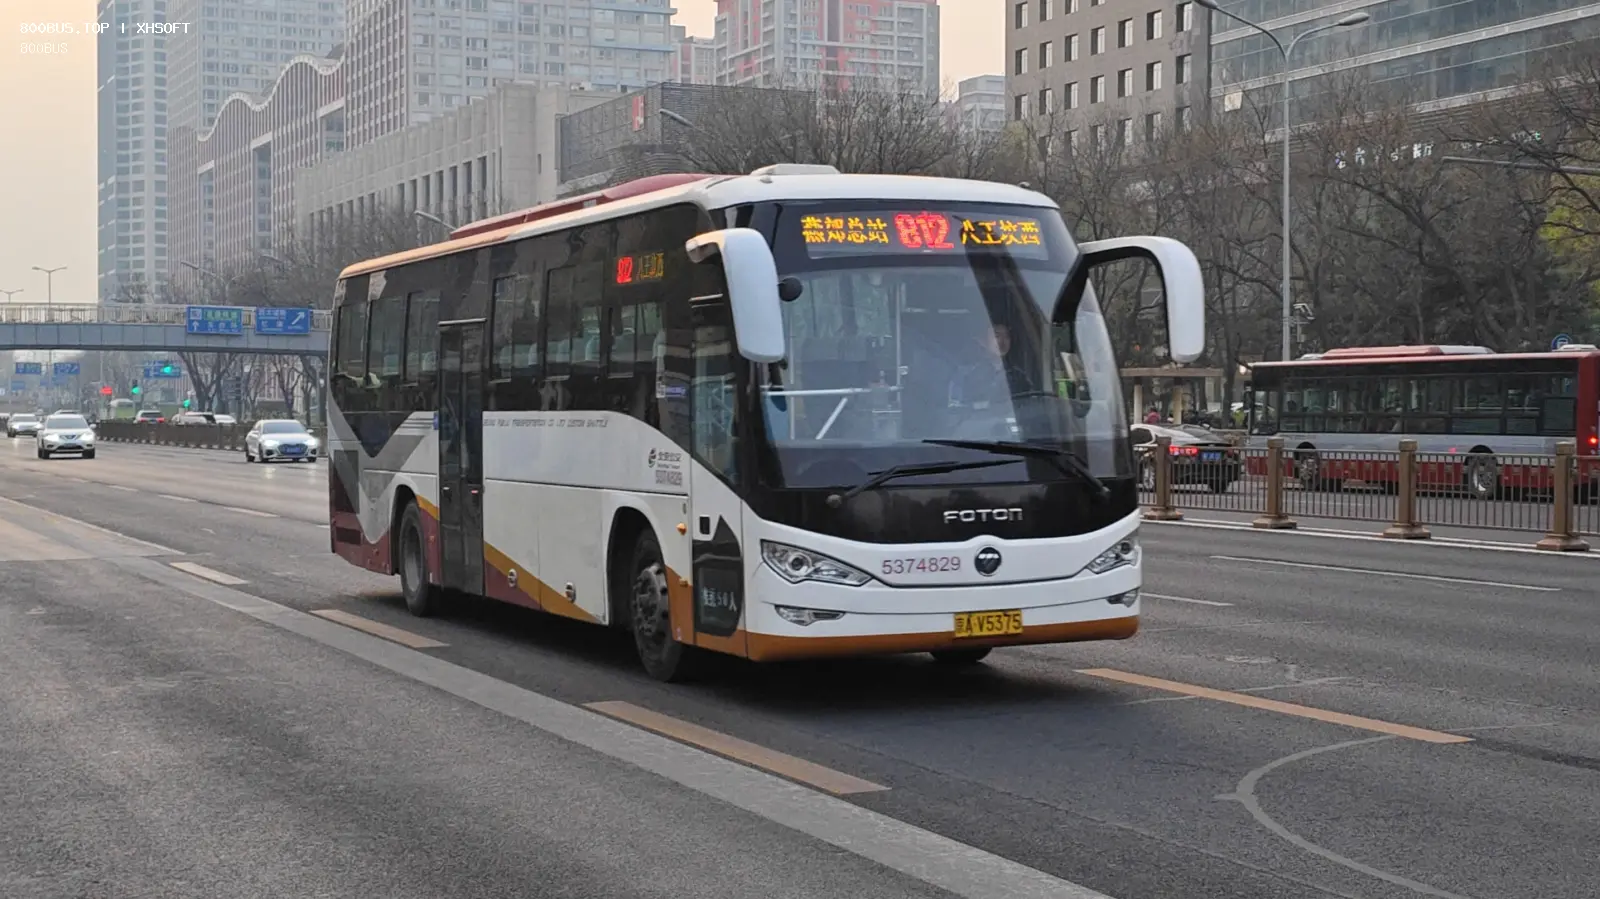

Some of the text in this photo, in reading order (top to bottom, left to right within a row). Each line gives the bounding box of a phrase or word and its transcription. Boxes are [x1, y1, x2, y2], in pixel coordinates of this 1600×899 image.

[894, 212, 955, 249] 812
[943, 508, 1024, 524] FOTON
[882, 556, 962, 575] 5374829
